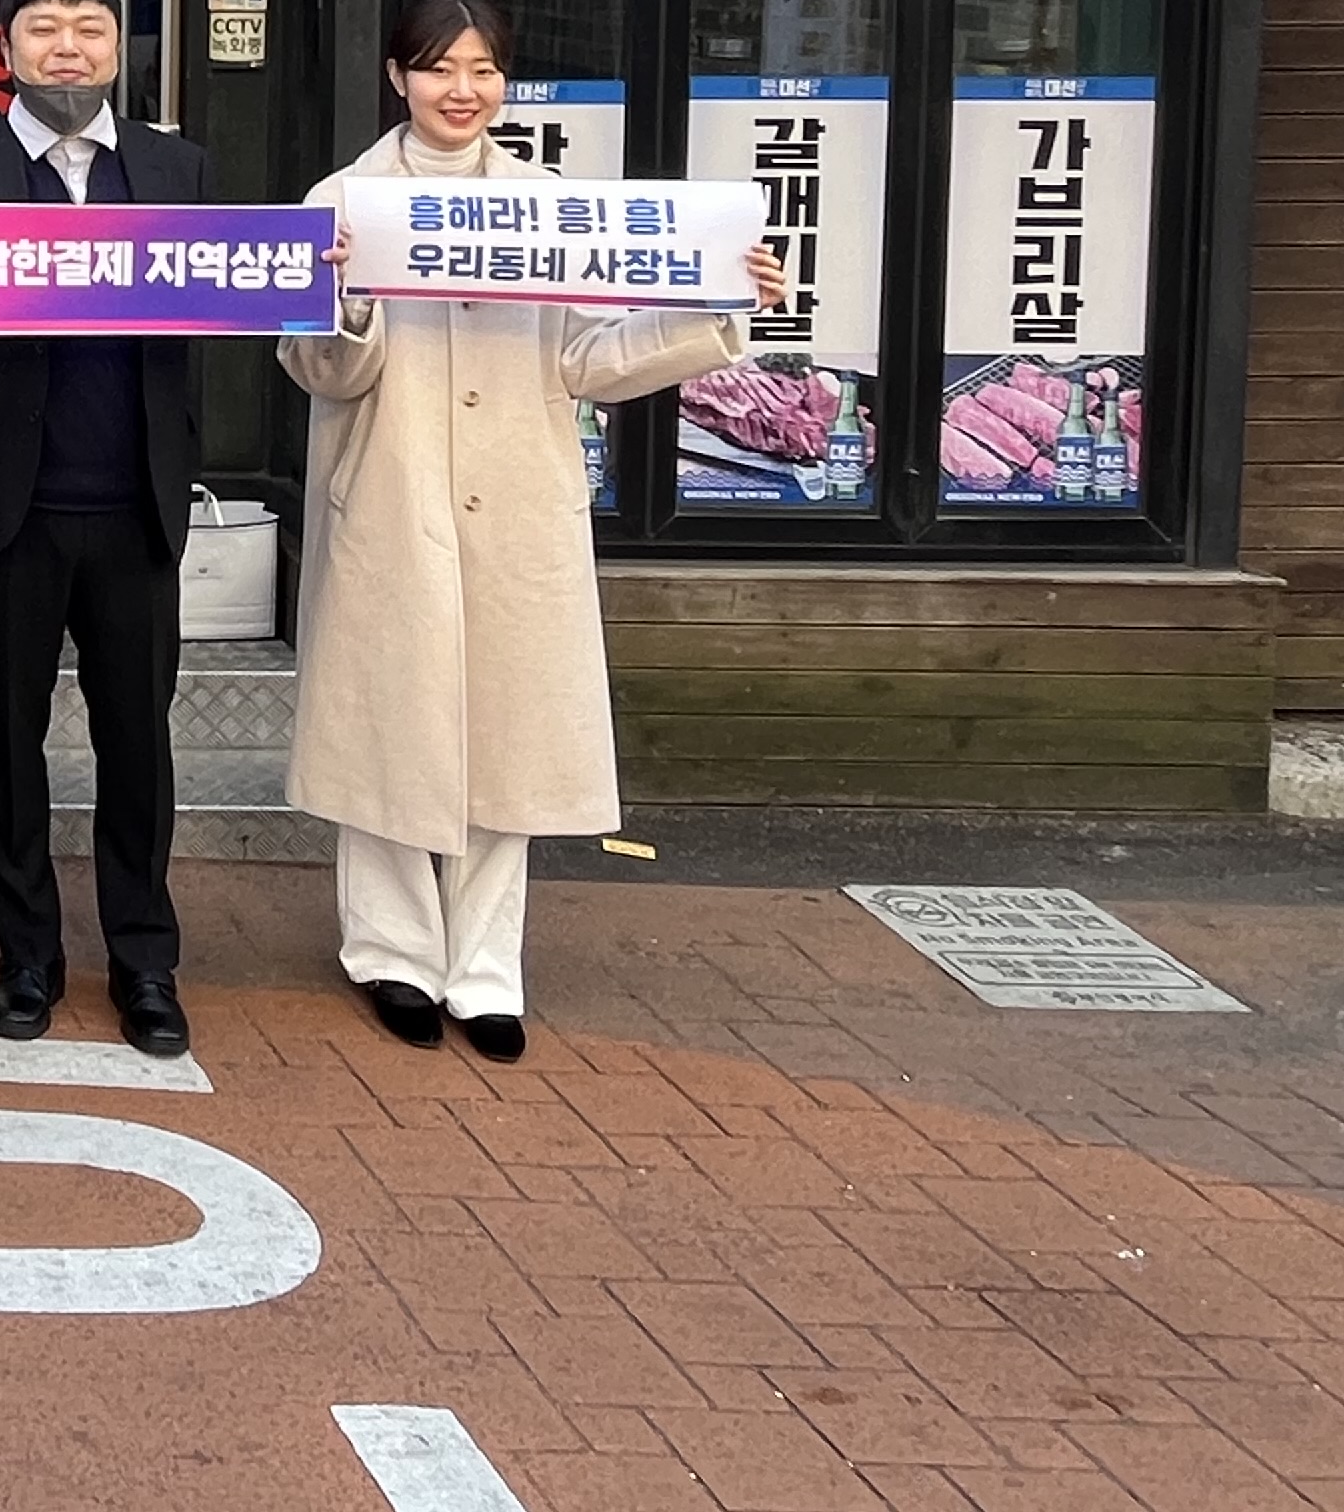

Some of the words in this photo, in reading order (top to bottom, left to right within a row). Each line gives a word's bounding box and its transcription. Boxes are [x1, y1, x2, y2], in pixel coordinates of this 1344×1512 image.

[214, 19, 262, 34] CCTV
[408, 195, 540, 234] 흥해라!
[556, 197, 607, 234] 흥!
[624, 198, 677, 236] 흥!
[1010, 118, 1092, 343] 가브리살
[144, 240, 314, 290] 지역상생
[407, 243, 566, 283] 우리동네
[581, 247, 703, 287] 사장님
